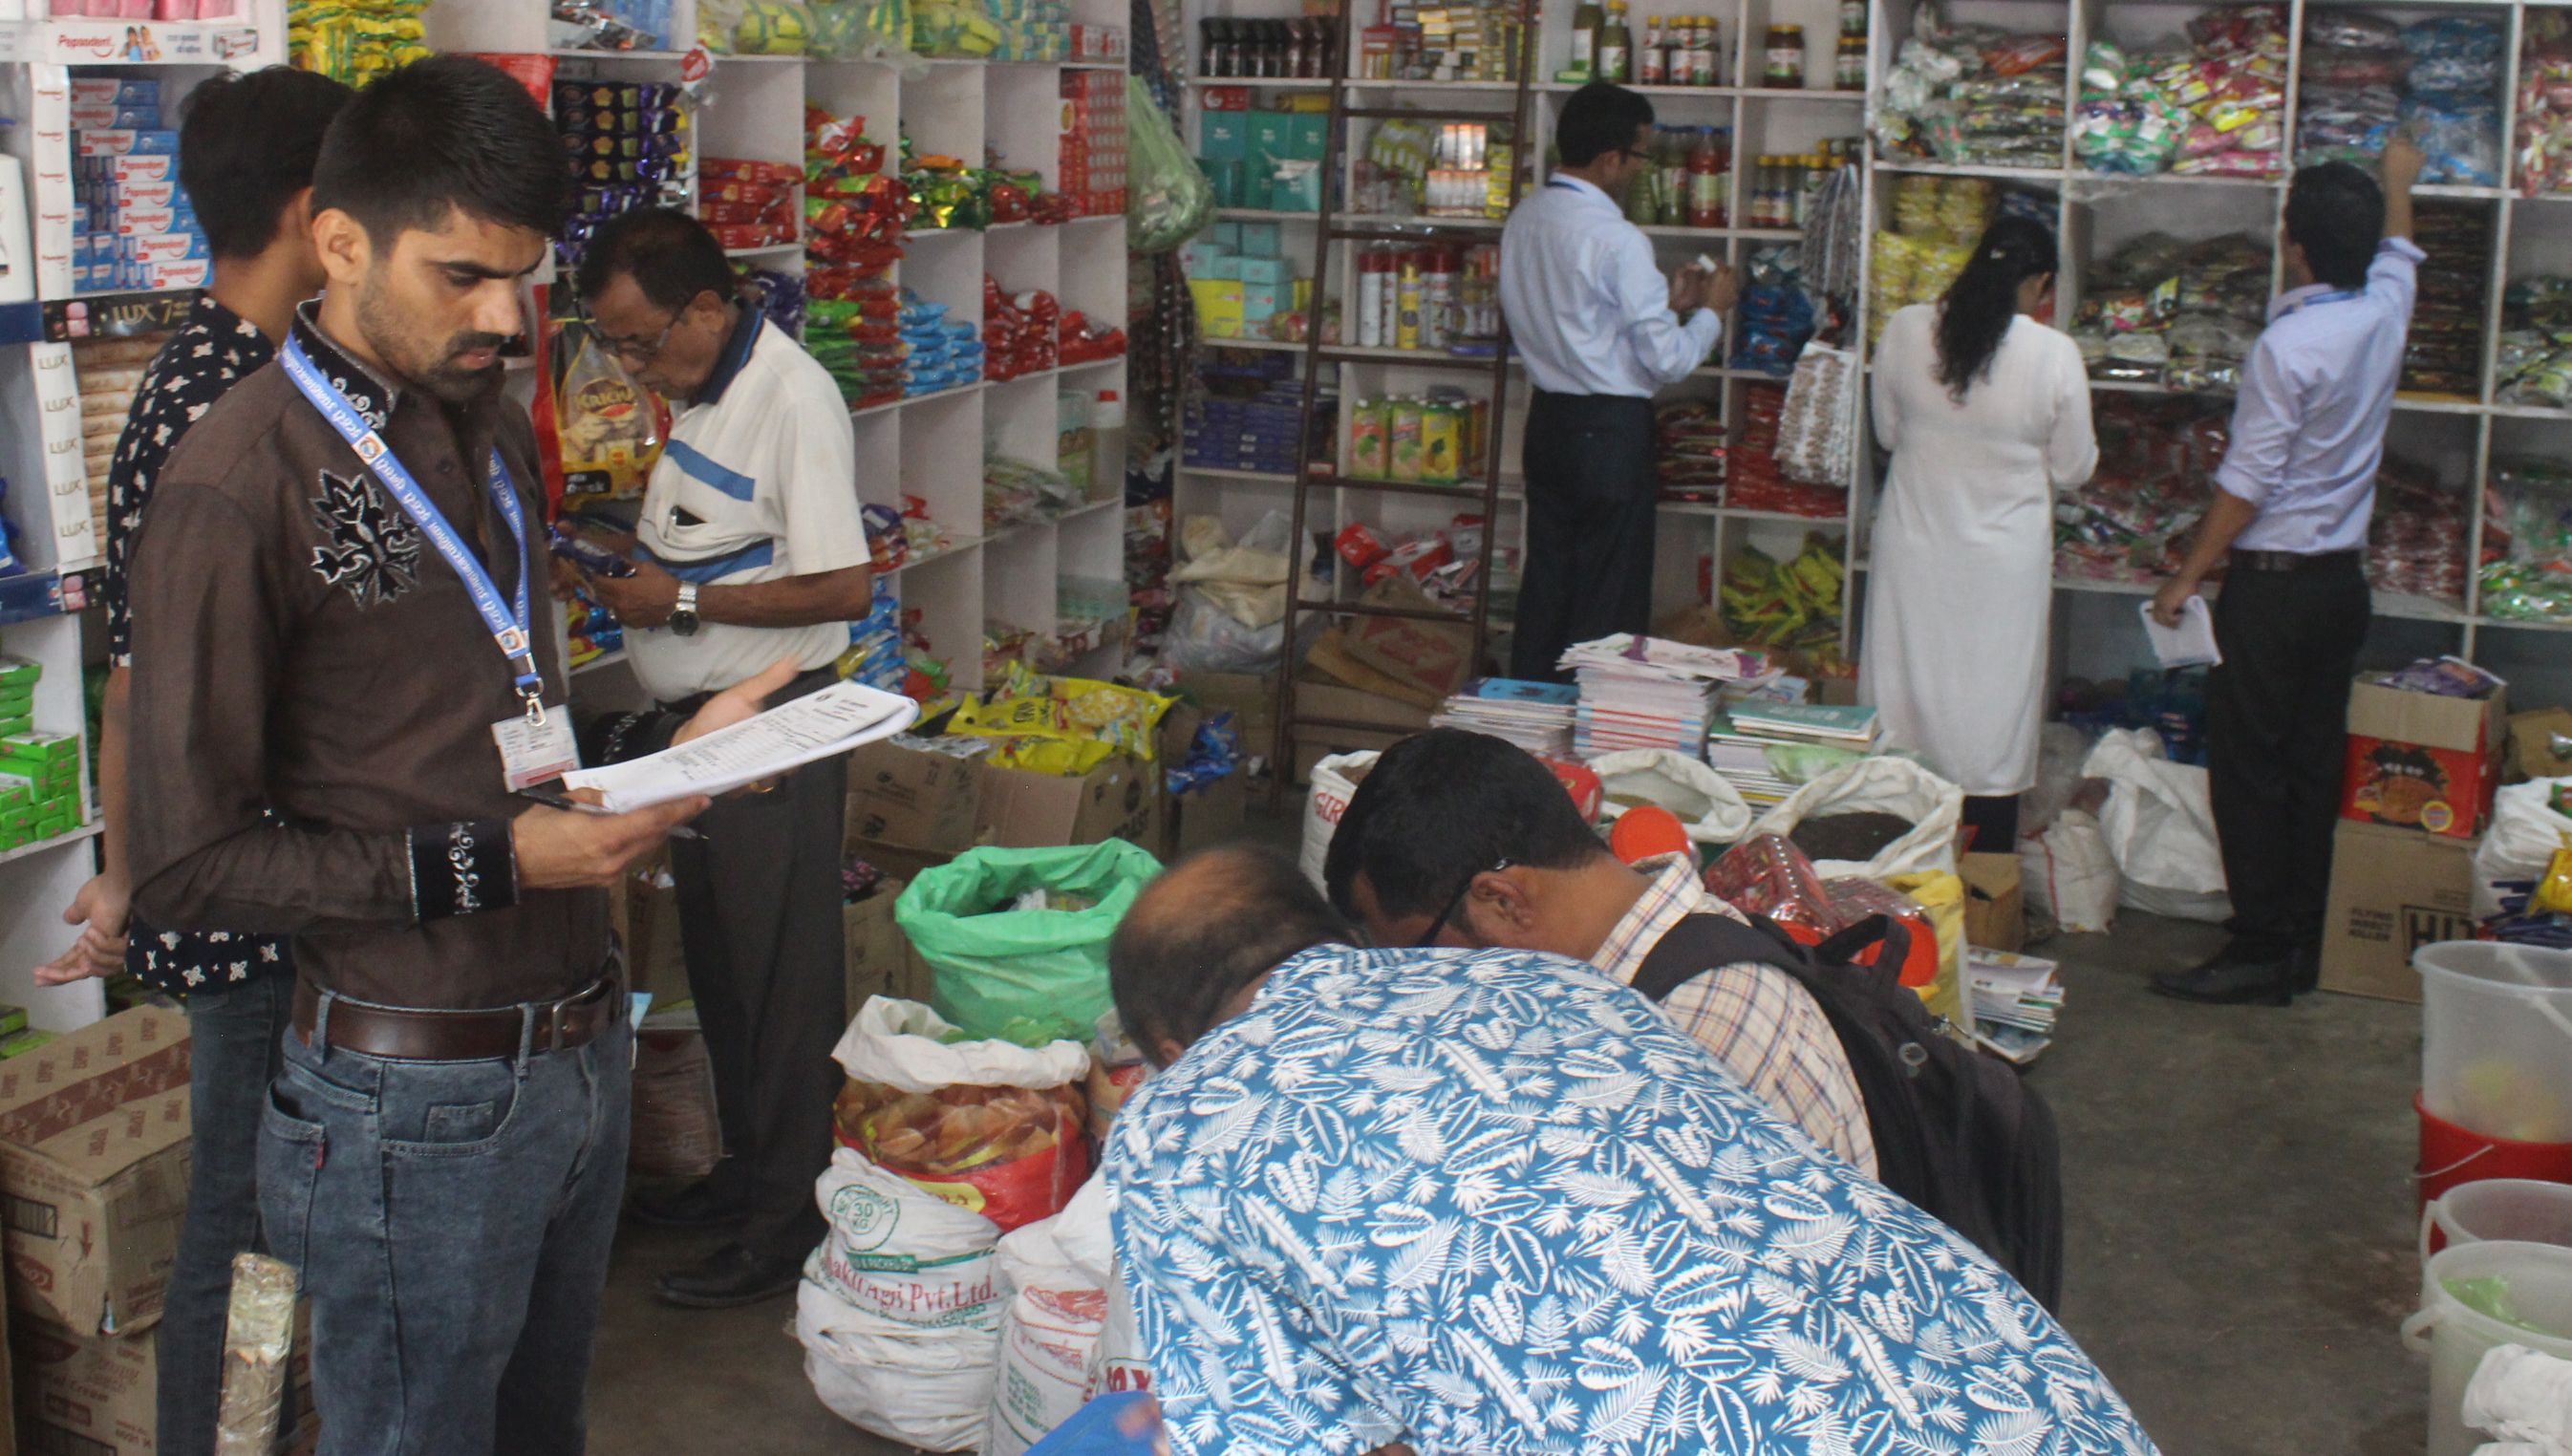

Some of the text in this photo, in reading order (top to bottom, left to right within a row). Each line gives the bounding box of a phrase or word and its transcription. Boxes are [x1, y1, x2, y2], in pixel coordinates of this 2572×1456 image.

[57, 33, 114, 49] Pepsodent
[112, 303, 156, 325] LUX
[853, 1202, 873, 1218] 30
[852, 1217, 869, 1229] KG
